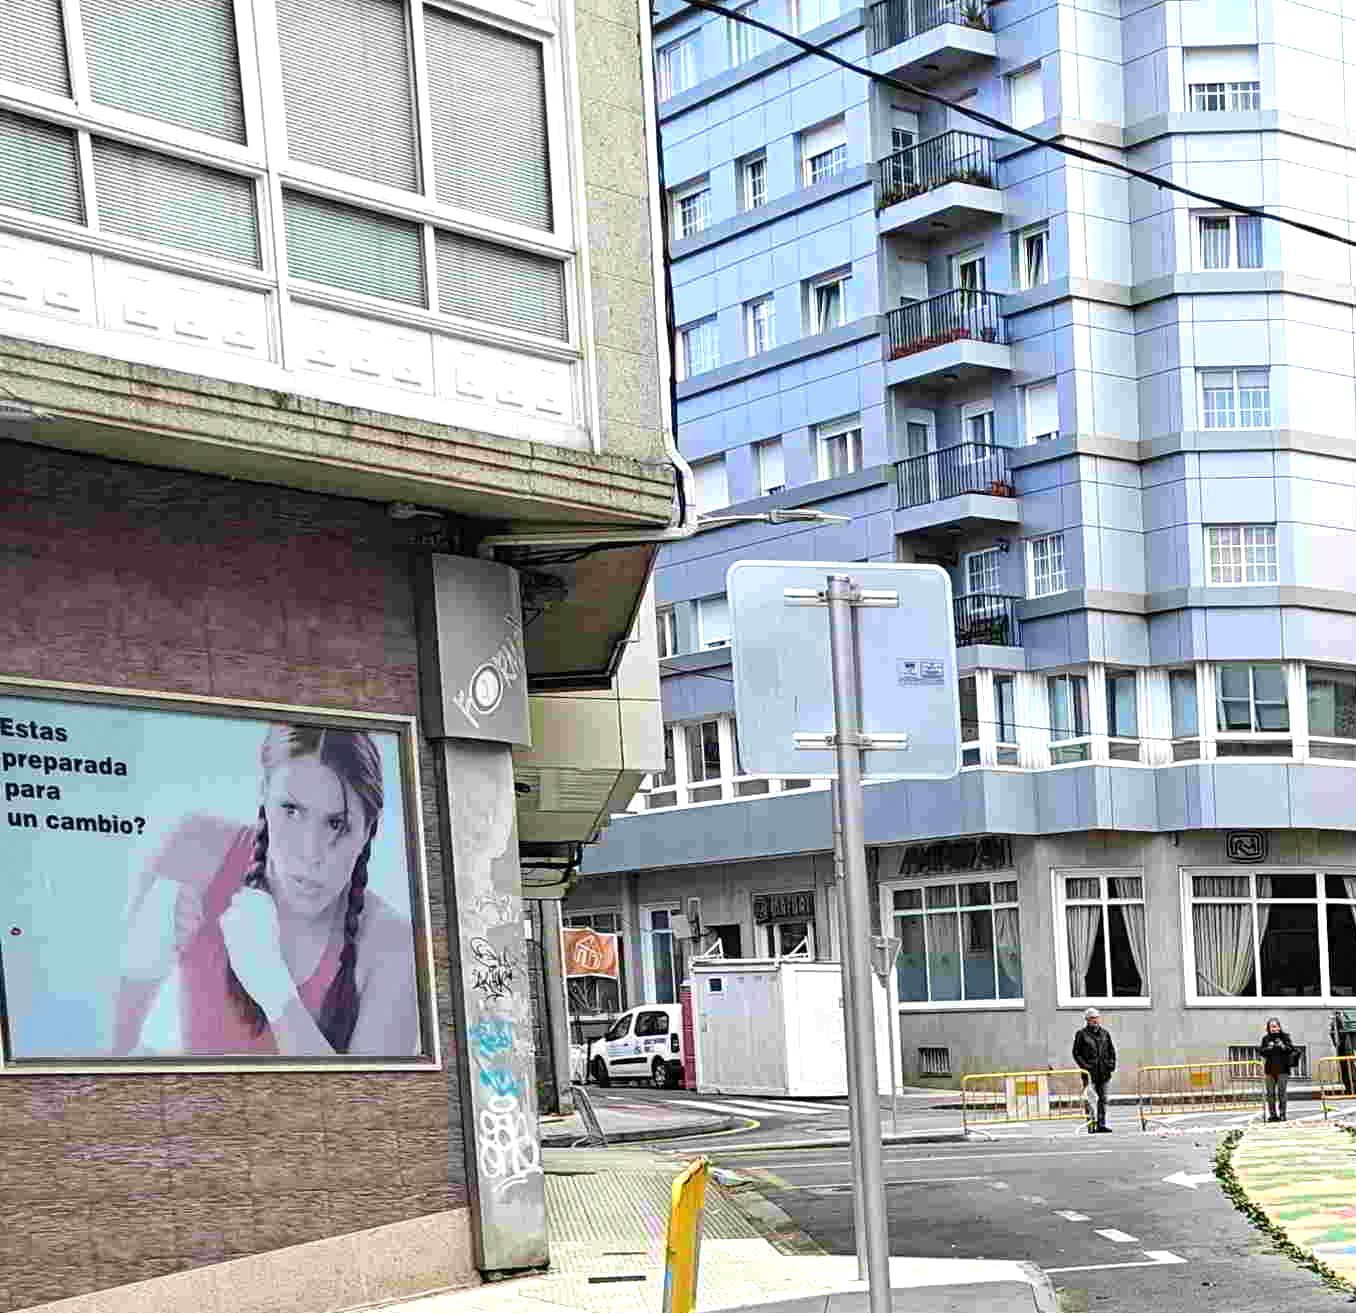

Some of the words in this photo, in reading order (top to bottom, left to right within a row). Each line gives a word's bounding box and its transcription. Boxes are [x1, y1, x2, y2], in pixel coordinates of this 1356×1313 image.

[0, 717, 68, 742] Estas
[2, 752, 127, 776] preparada
[5, 782, 60, 801] para
[7, 812, 38, 828] un
[45, 814, 146, 835] cambio?
